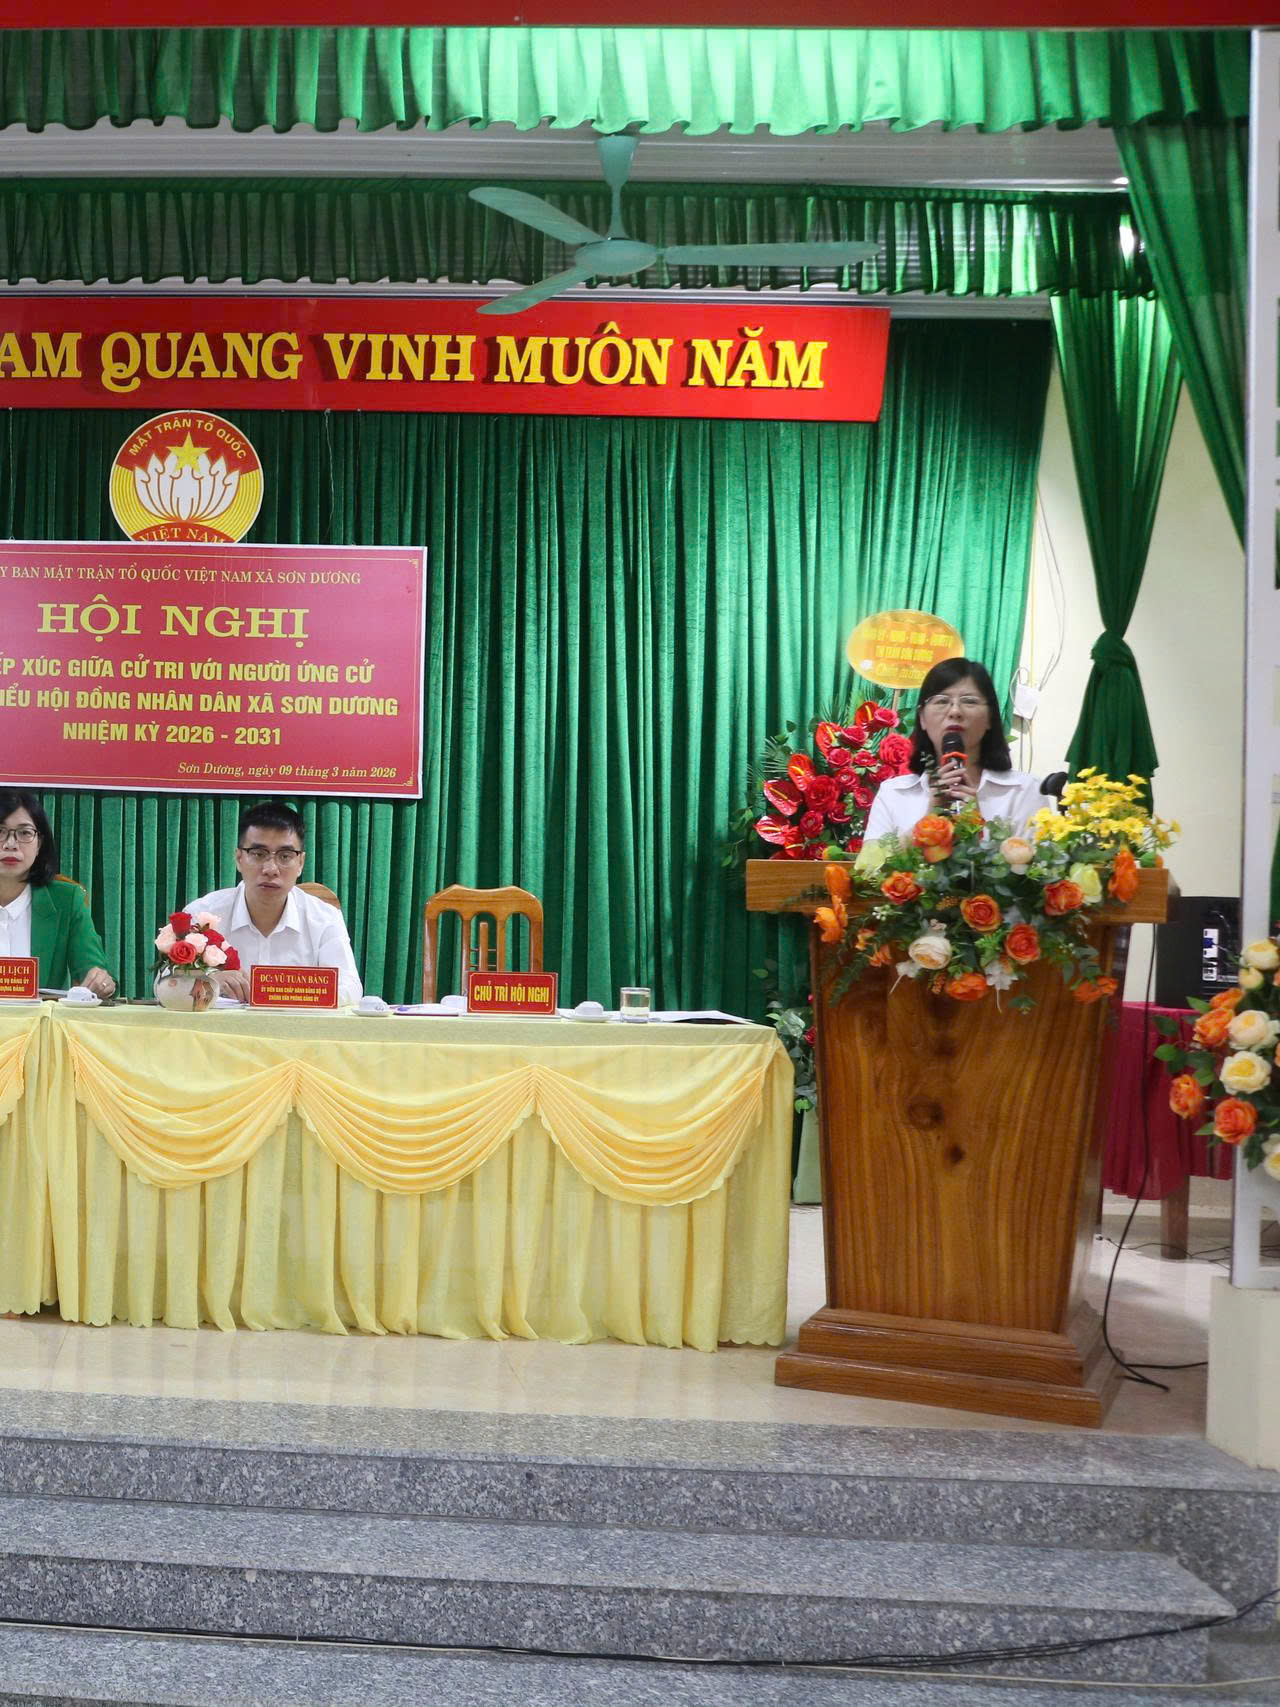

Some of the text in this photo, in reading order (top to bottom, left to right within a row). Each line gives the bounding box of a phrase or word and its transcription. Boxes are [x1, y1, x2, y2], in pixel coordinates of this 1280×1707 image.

[101, 331, 304, 394] QUANG
[323, 333, 476, 382] VINH
[493, 322, 674, 386] MUÔN
[688, 326, 828, 390] NĂM
[128, 417, 247, 459] MẶT TRẬN TỔ QUỐC
[139, 526, 181, 542] VIỆT
[12, 566, 40, 578] BAN
[43, 564, 74, 581] MẶT
[77, 564, 115, 582] TRẬN
[119, 562, 137, 580] TỔ
[141, 564, 181, 582] QUỐC
[184, 566, 217, 585] VIỆT
[221, 571, 252, 583] NAM
[255, 569, 274, 584] XÃ
[277, 571, 306, 584] SƠN
[310, 571, 361, 584] DƯƠNG
[37, 593, 309, 648] HỘI NGHỊ
[22, 655, 61, 677] XÚC
[68, 656, 114, 678] GIỮA
[120, 653, 150, 678] CỬ
[153, 661, 183, 680] TRI
[190, 658, 222, 681] VỚI
[229, 659, 290, 682] NGƯỜI
[297, 660, 338, 683] ỨNG
[345, 658, 375, 683] CỬ
[37, 687, 69, 712] HỘI
[76, 686, 131, 710] ĐỒNG
[137, 690, 193, 712] NHÂN
[199, 691, 241, 713] DÂN
[247, 693, 274, 714] XÃ
[281, 695, 322, 714] SƠN
[329, 696, 398, 716] DƯƠNG
[63, 720, 128, 744] NHIỆM
[134, 721, 160, 742] KỲ
[166, 725, 214, 744] 2026
[234, 727, 281, 745] 2031
[178, 762, 397, 779] Sơn Dương, ngày 09 tháng 3 năm 2026
[8, 965, 30, 975] LỊCH
[474, 980, 550, 1006] CHỦ TRÌ HỘI NGHỊ
